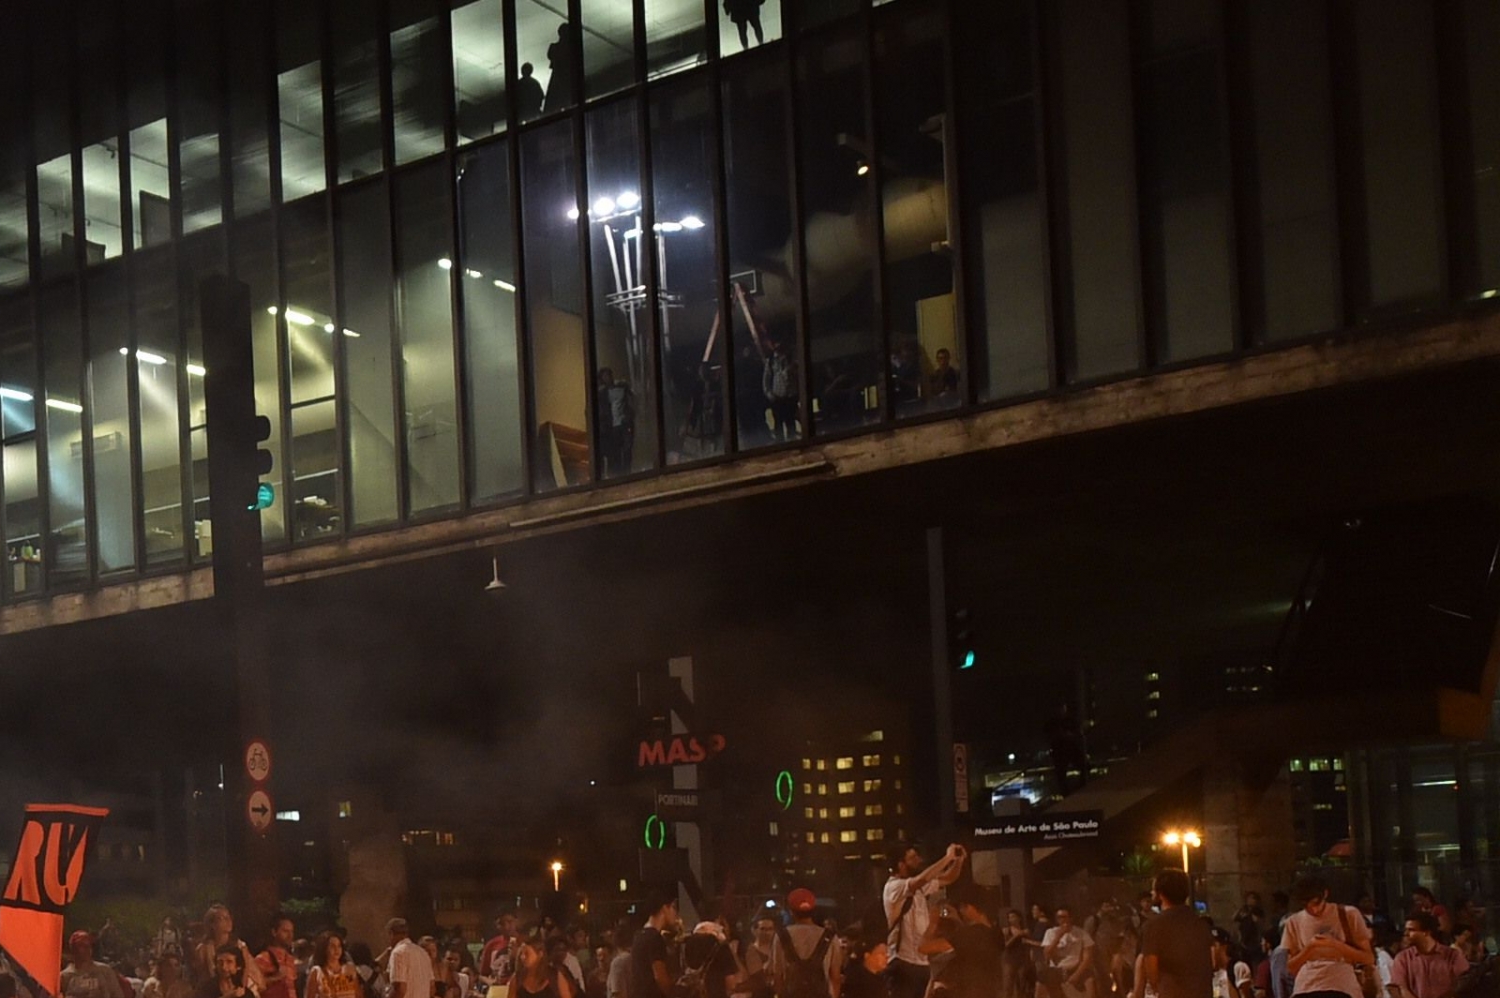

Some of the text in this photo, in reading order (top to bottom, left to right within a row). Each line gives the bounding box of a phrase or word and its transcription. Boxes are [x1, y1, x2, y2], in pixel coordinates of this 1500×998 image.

[974, 827, 1003, 837] Museu
[1004, 825, 1016, 834] de
[1017, 824, 1038, 834] Arte
[1039, 823, 1051, 832] de
[1072, 819, 1099, 830] Paulo
